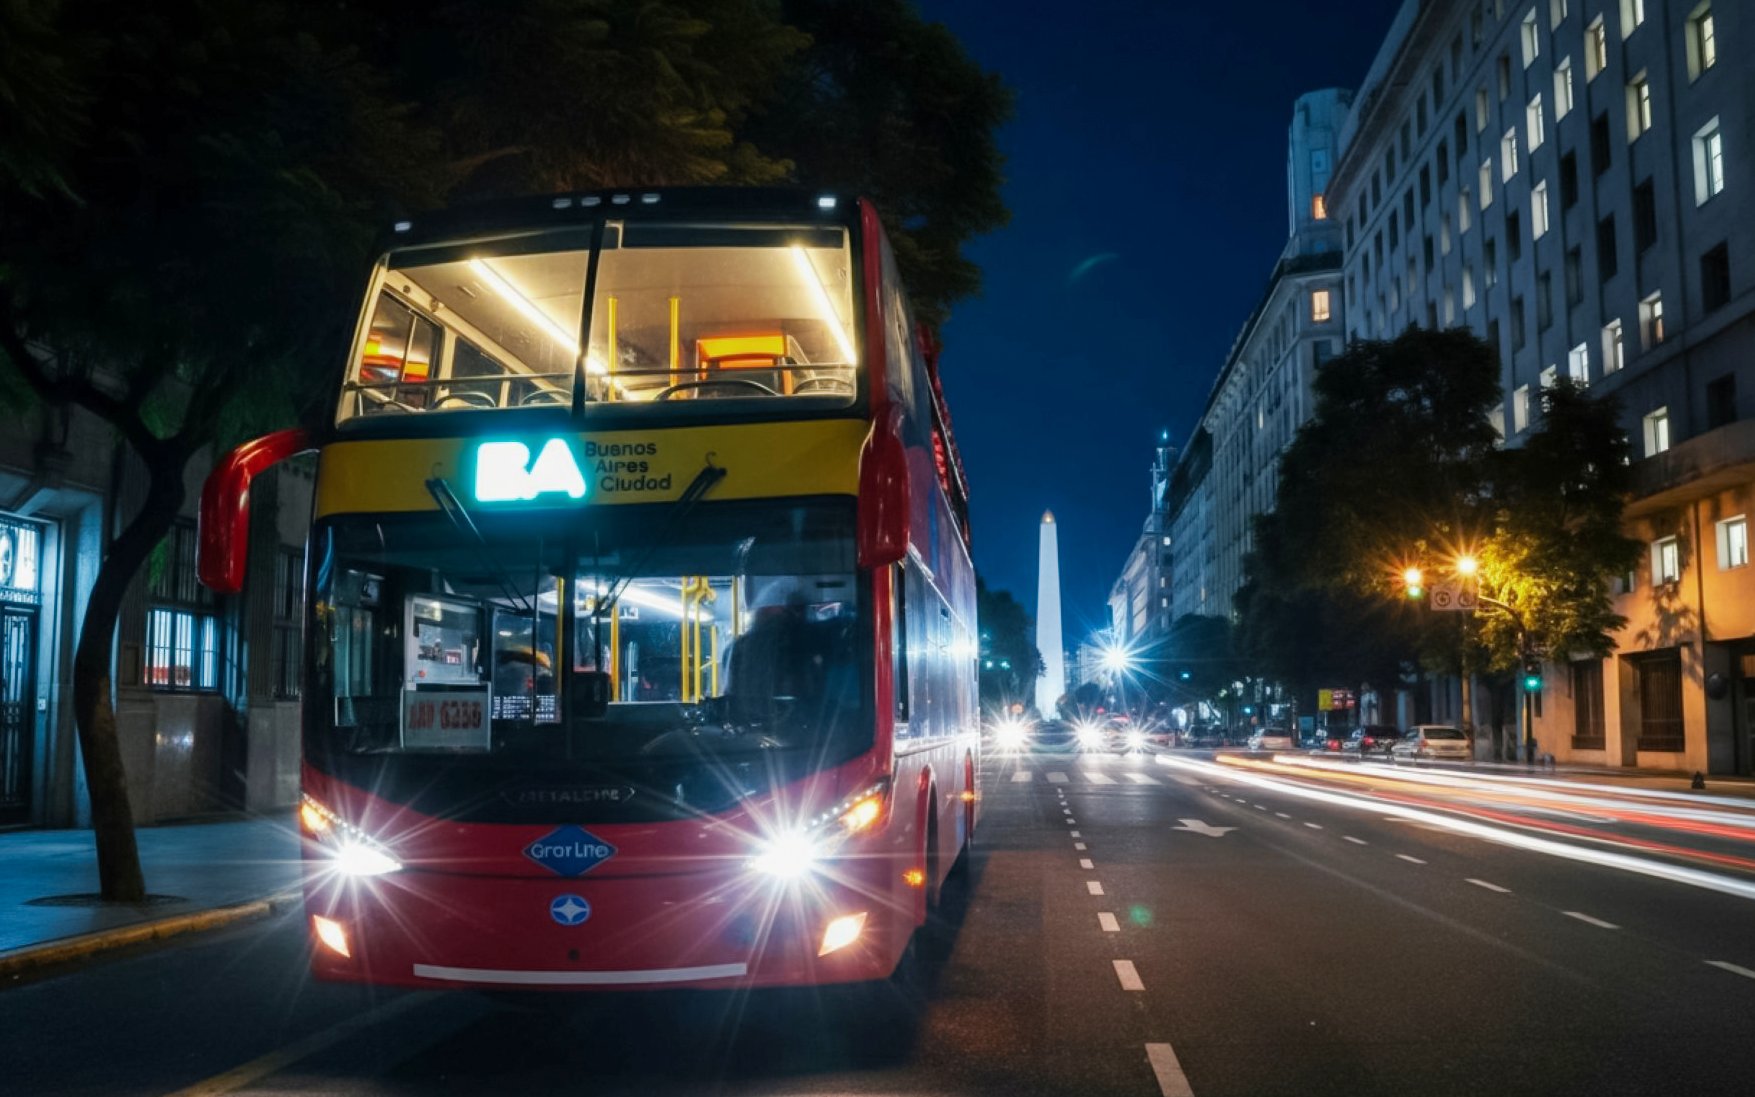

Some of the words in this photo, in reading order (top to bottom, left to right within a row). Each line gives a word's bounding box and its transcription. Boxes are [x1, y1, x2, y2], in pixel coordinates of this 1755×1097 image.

[585, 441, 657, 457] Buenos
[475, 438, 586, 501] BA
[595, 459, 649, 473] Aires
[600, 473, 672, 491] Ciudad
